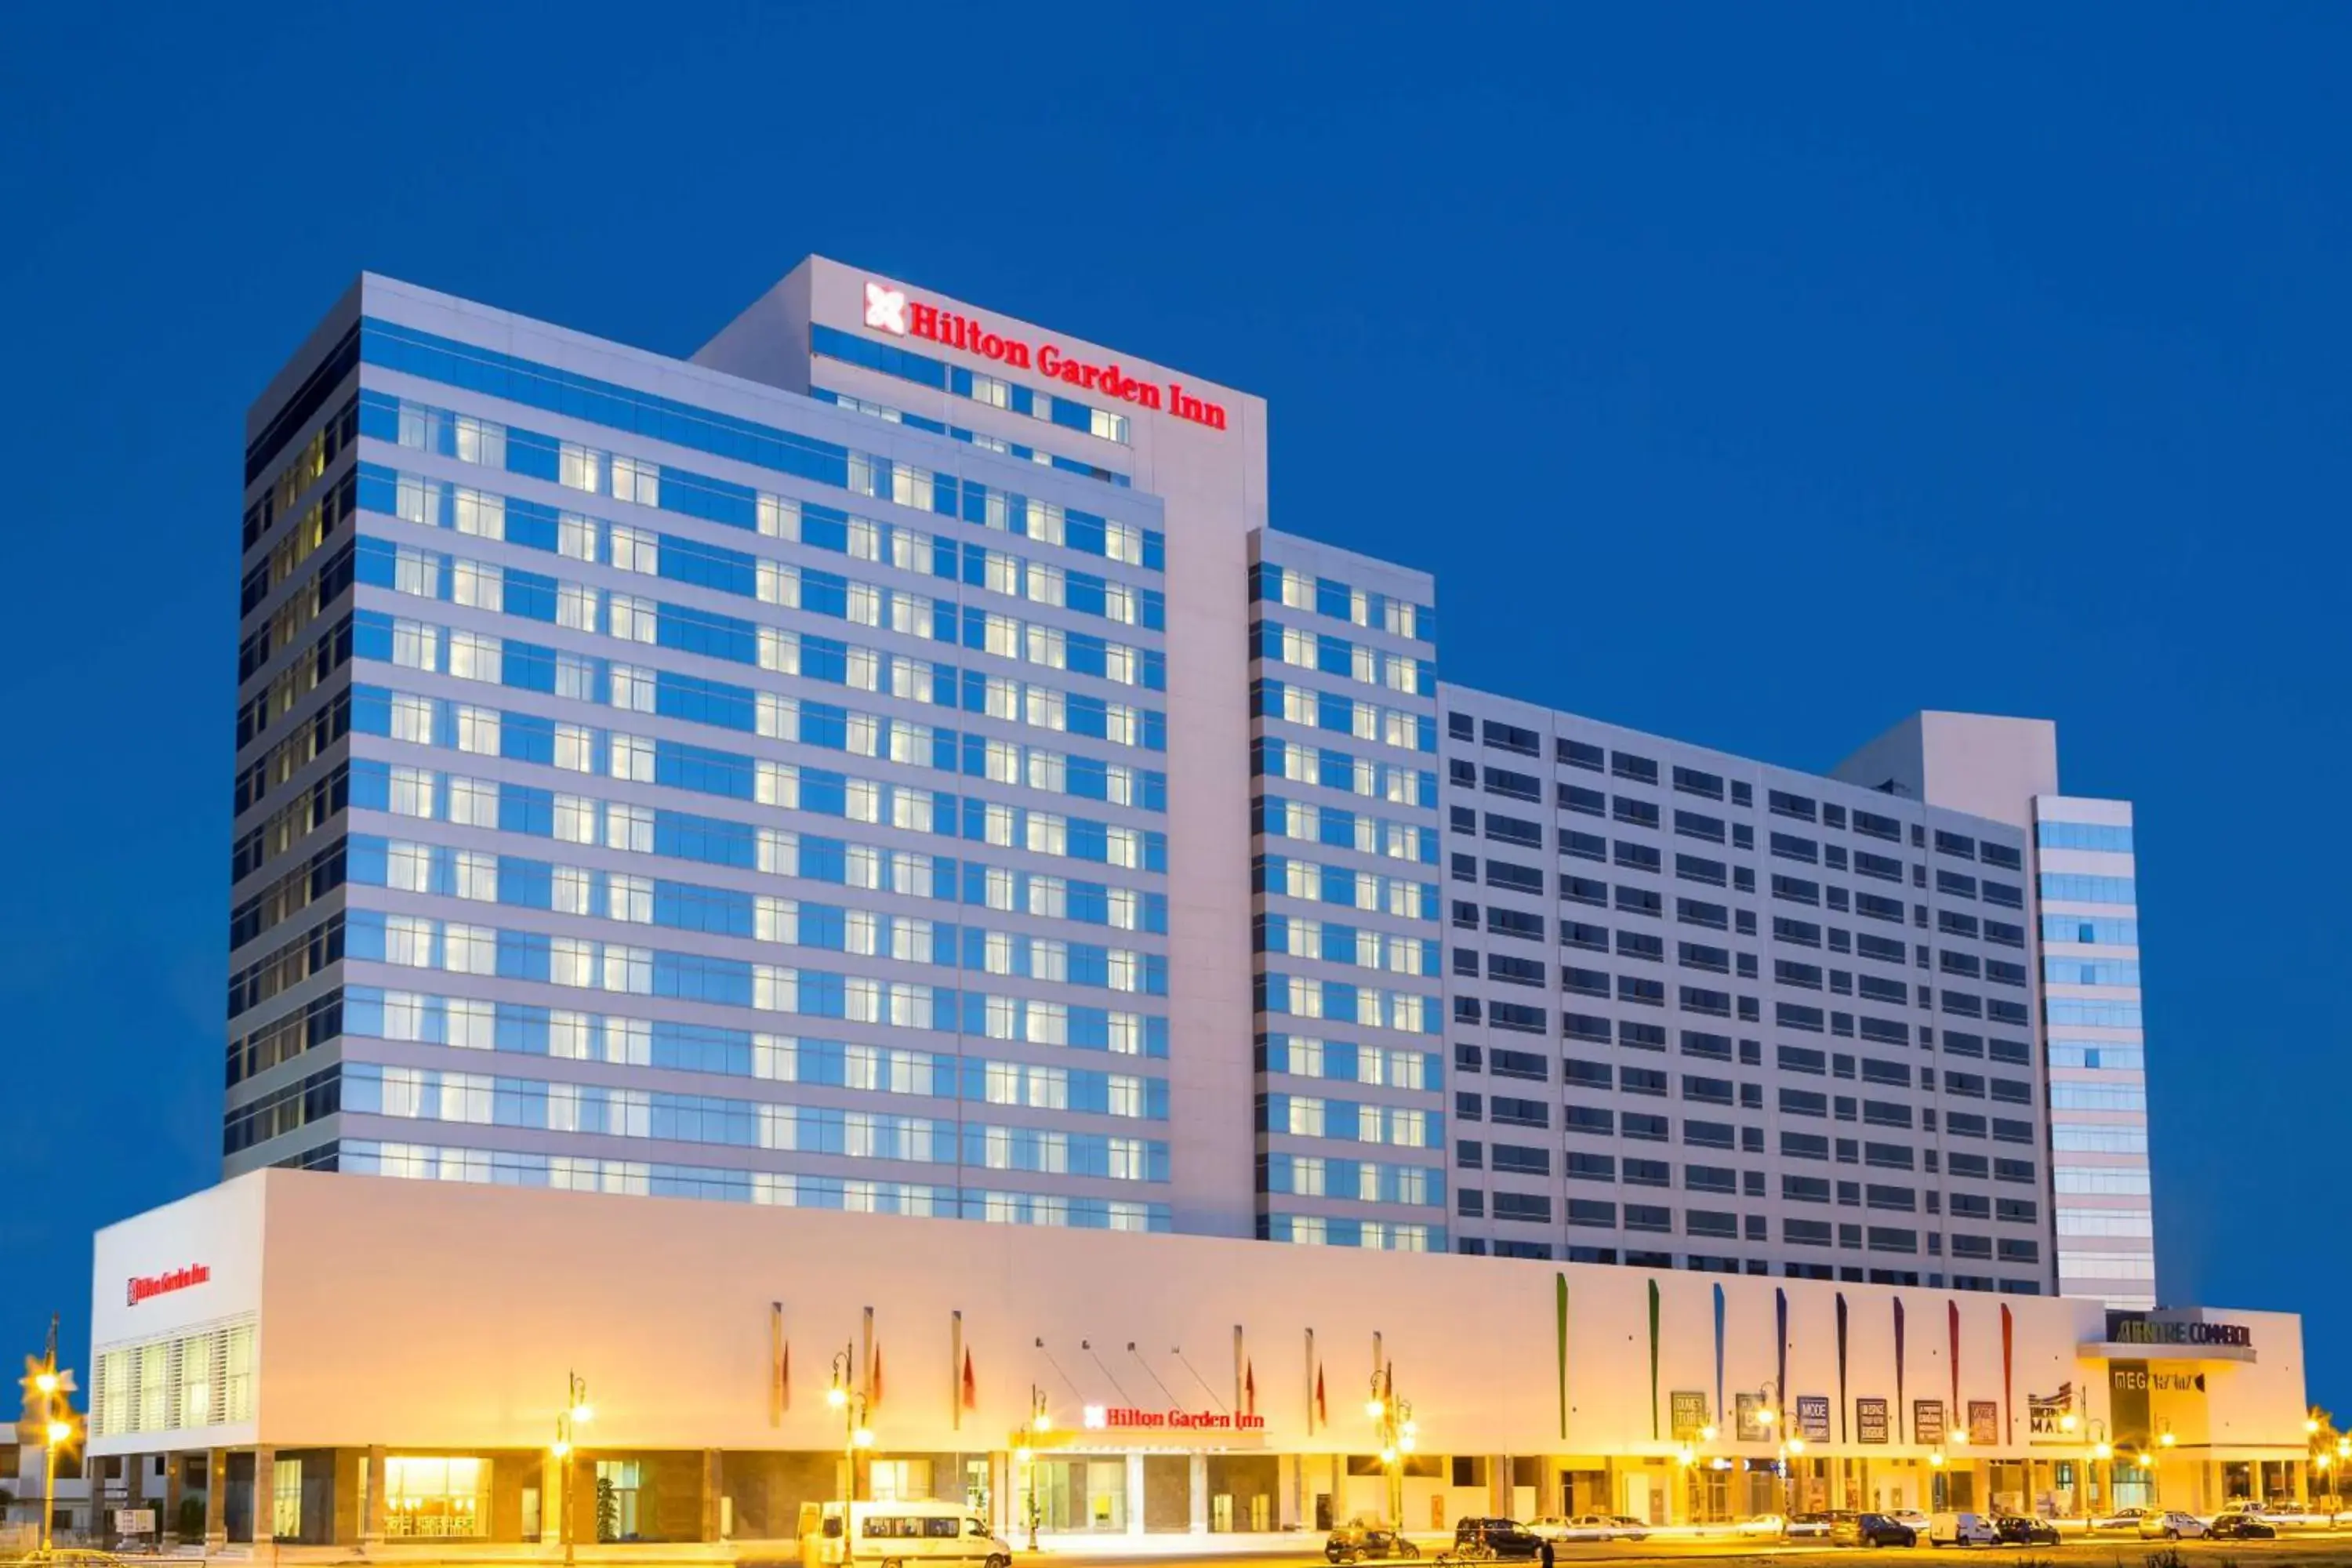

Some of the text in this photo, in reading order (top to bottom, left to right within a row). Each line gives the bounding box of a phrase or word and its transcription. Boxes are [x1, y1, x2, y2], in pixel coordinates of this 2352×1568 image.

[911, 301, 1227, 430] Hilton Garden Inn
[1107, 1409, 1265, 1430] Hilton Garden Inn
[2030, 1417, 2073, 1434] MAL
